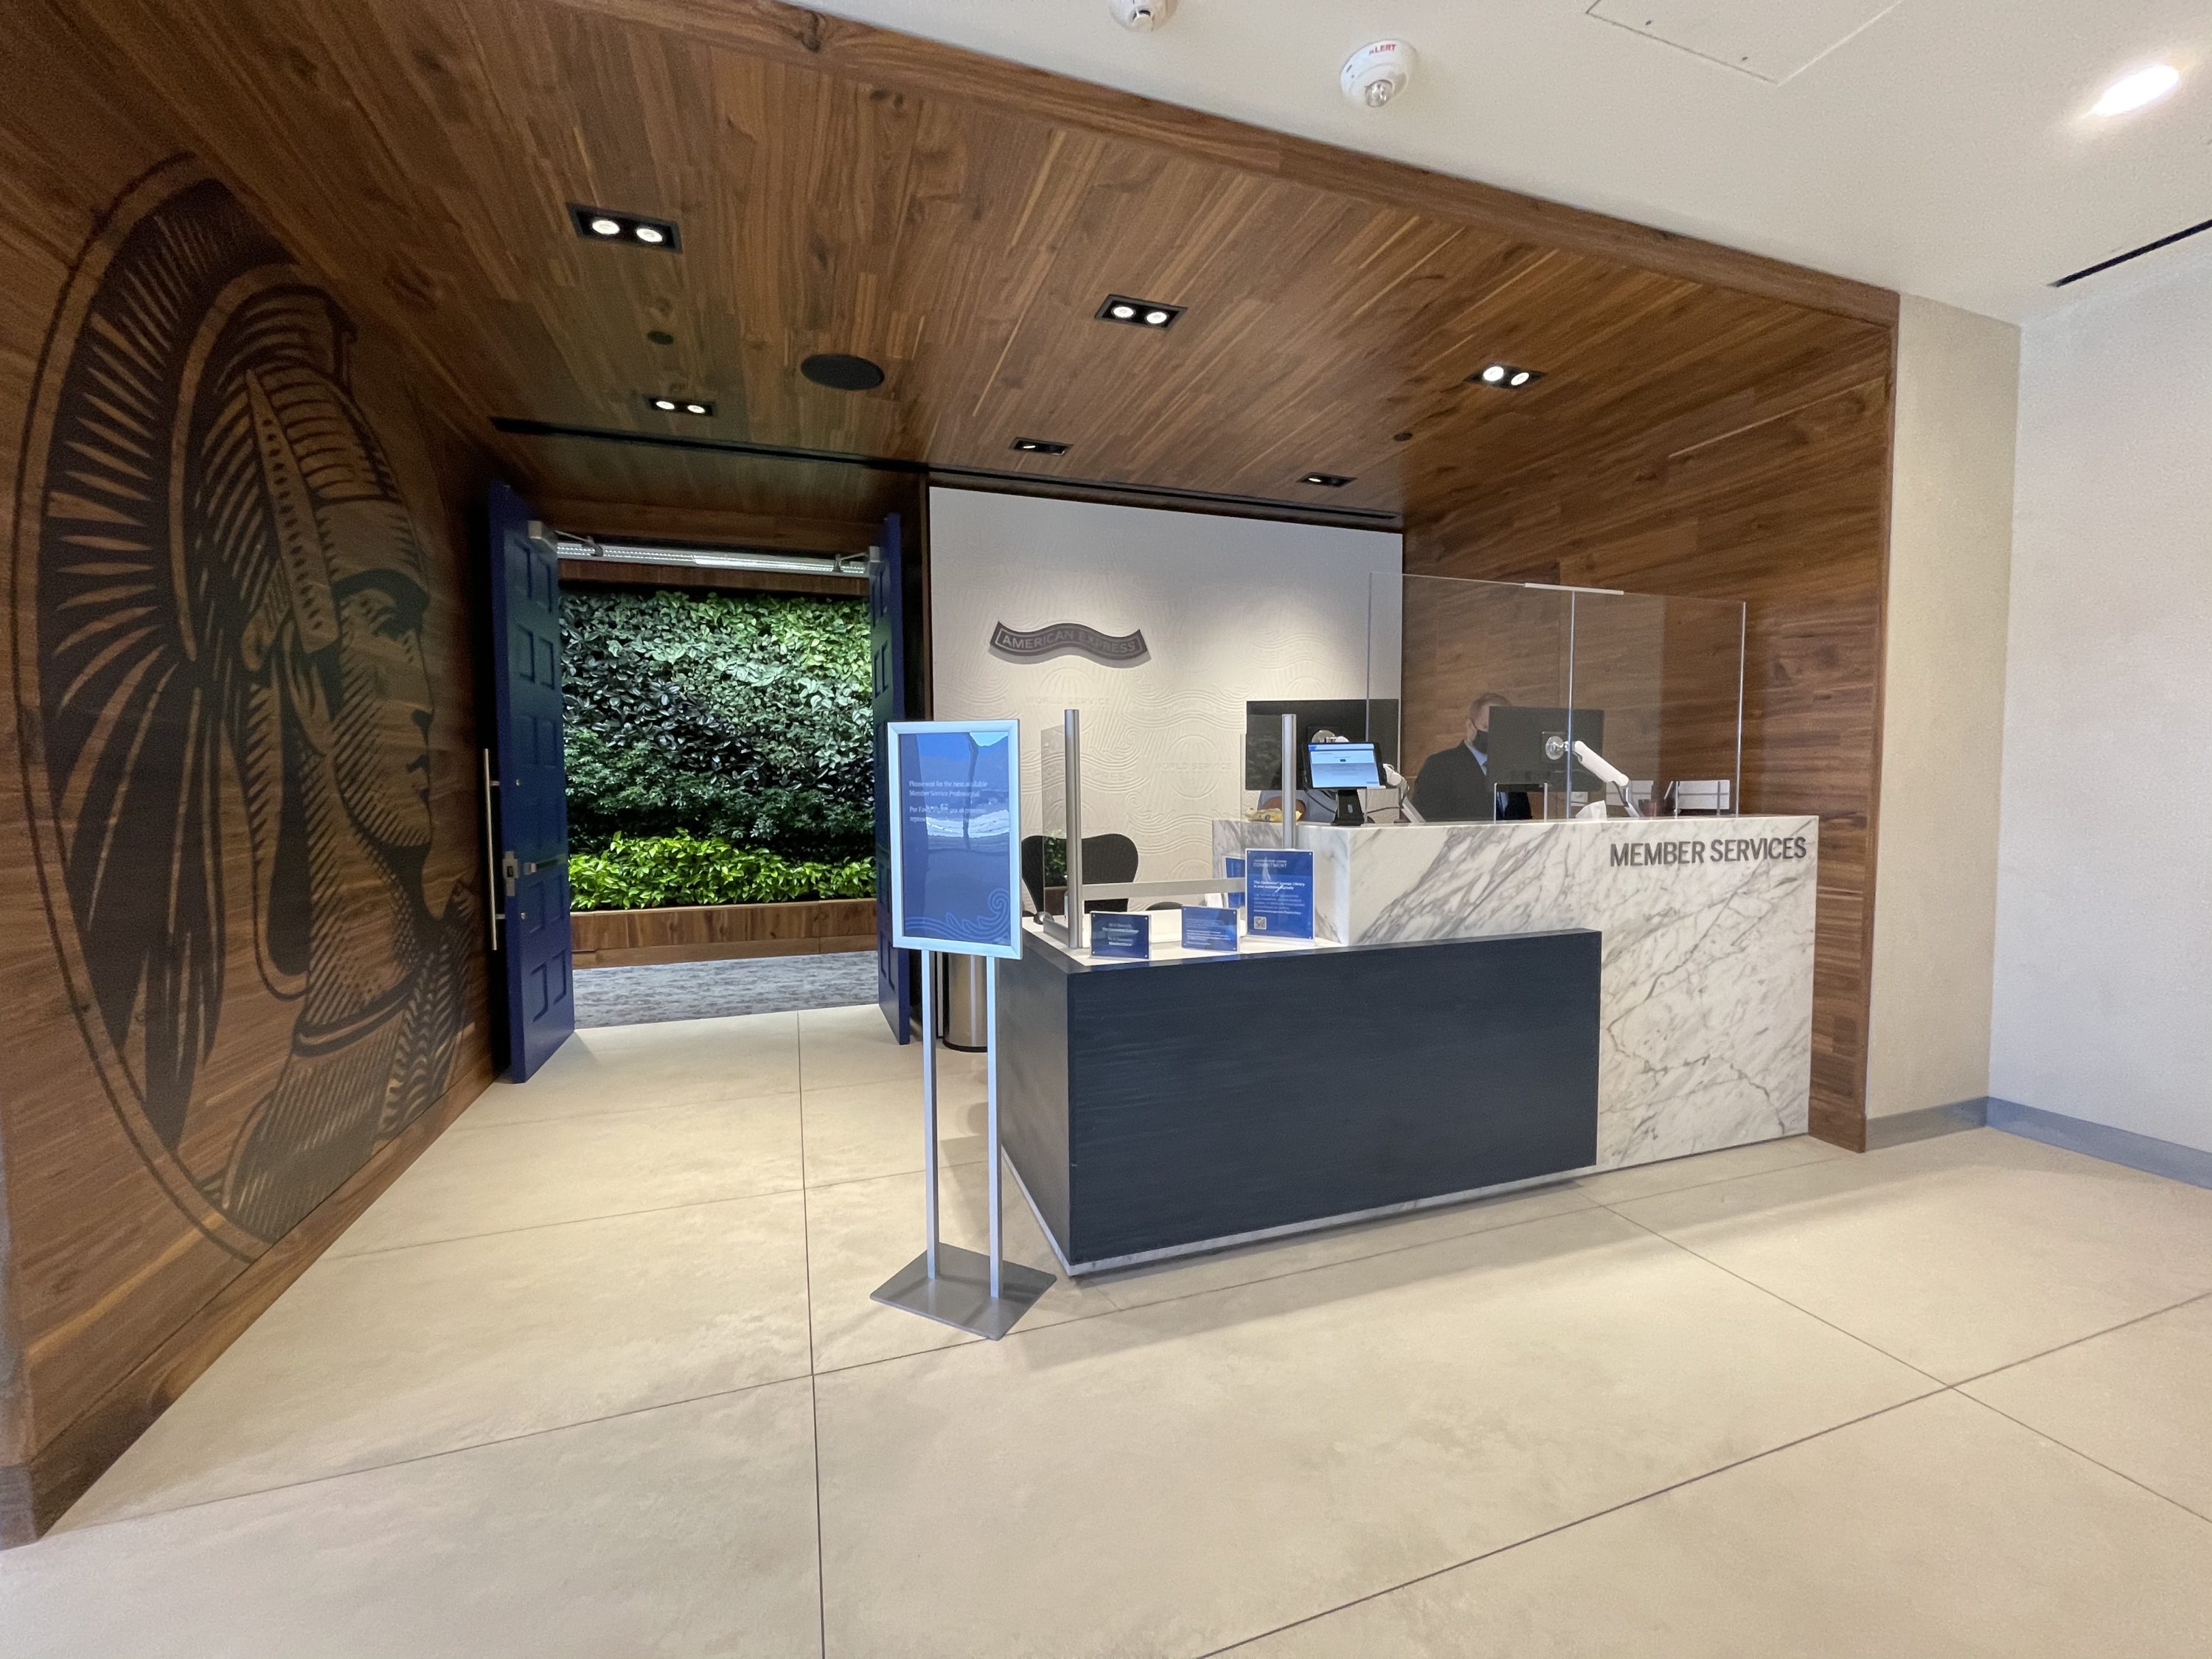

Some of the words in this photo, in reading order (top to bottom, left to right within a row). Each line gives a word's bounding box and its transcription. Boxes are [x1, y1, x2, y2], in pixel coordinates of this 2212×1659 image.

[1368, 44, 1397, 56] ALERT
[1002, 630, 1074, 649] AMERICAN
[1078, 631, 1136, 653] EXPRESS
[1610, 841, 1705, 867] MEMBER
[1710, 836, 1807, 863] SERVICES
